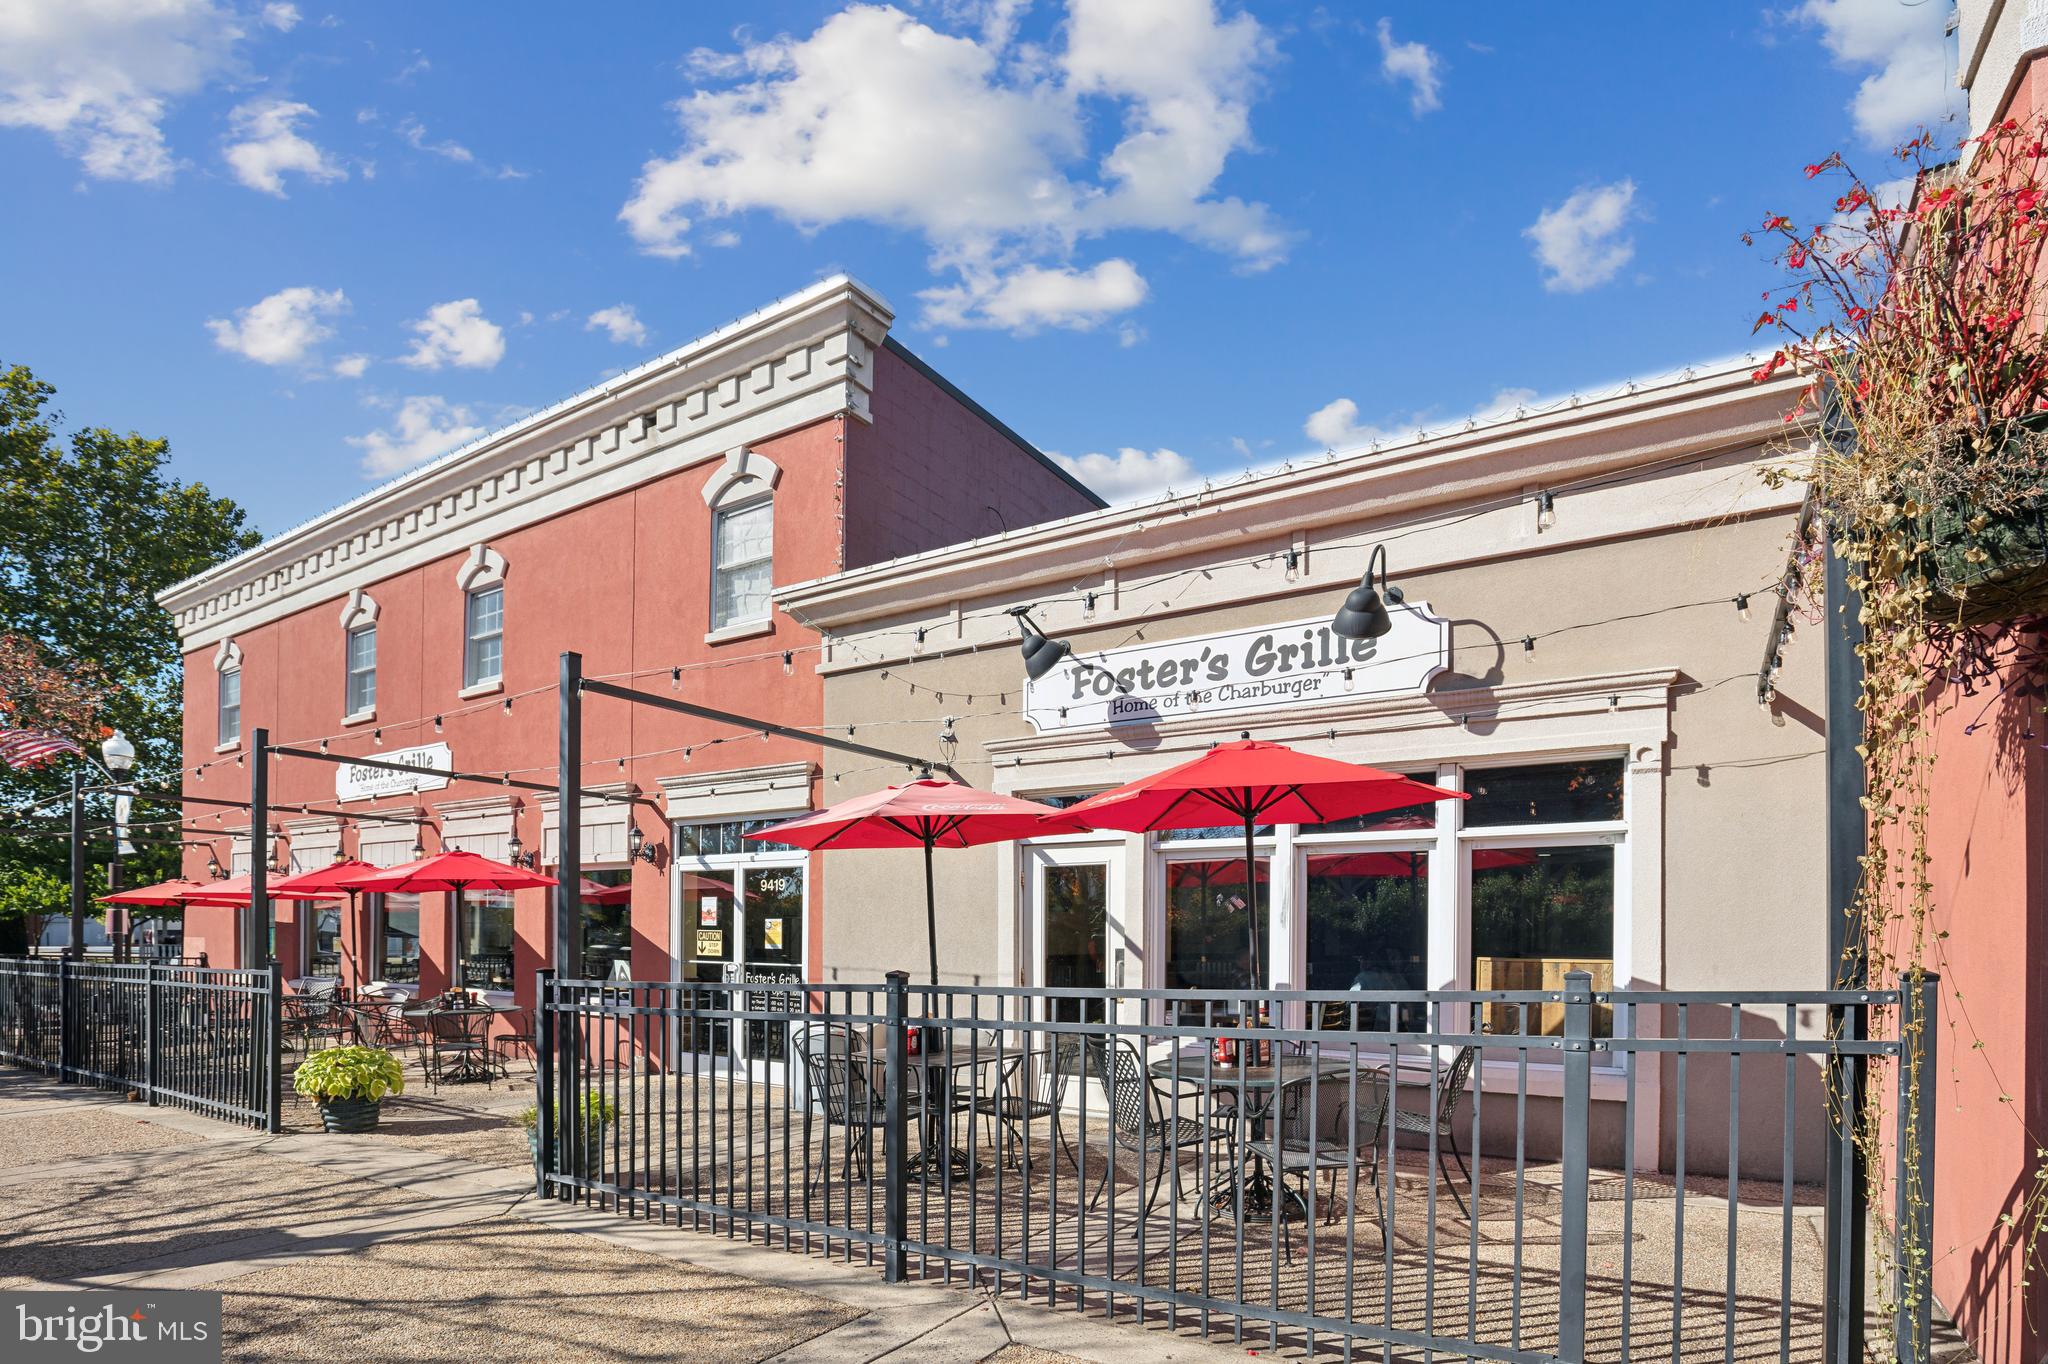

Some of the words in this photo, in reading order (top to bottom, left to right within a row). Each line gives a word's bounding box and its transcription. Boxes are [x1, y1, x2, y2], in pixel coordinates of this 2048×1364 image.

[1071, 646, 1229, 700] Foster's
[1245, 627, 1378, 676] Grille
[1163, 692, 1181, 707] of
[1184, 687, 1212, 705] the
[761, 879, 785, 891] 9419
[698, 931, 721, 941] CAUTION
[745, 971, 776, 985] Foster's
[779, 973, 800, 985] Grille
